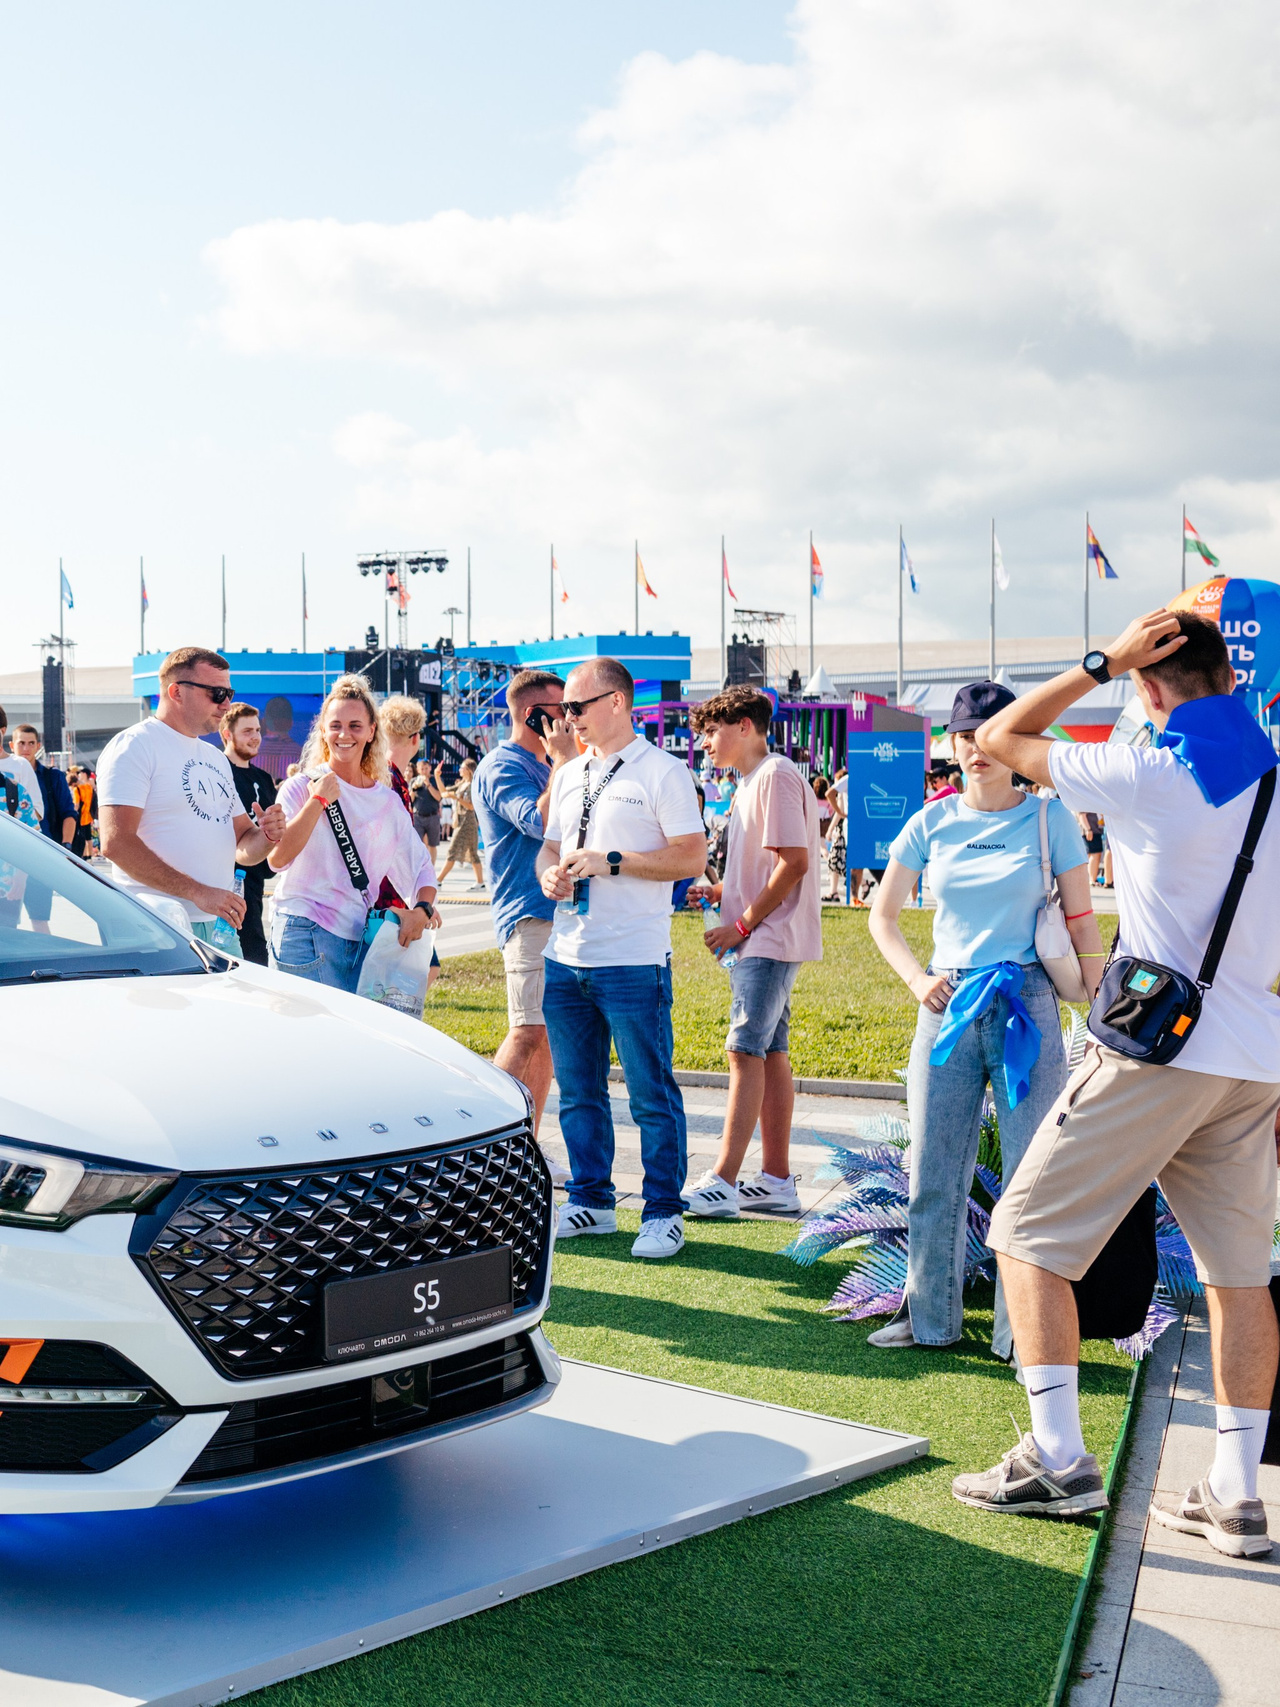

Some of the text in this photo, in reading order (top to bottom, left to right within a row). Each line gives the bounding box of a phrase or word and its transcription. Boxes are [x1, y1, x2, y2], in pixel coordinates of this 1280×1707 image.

[878, 742, 894, 750] VK
[181, 759, 212, 821] ARMANI EXCHANGE
[608, 795, 643, 806] OMODA
[344, 845, 363, 878] KARL
[256, 1107, 473, 1148] OMODA
[413, 1278, 441, 1314] S5
[337, 1343, 366, 1355] КЛЮЧАВТО
[373, 1334, 407, 1348] OMODA
